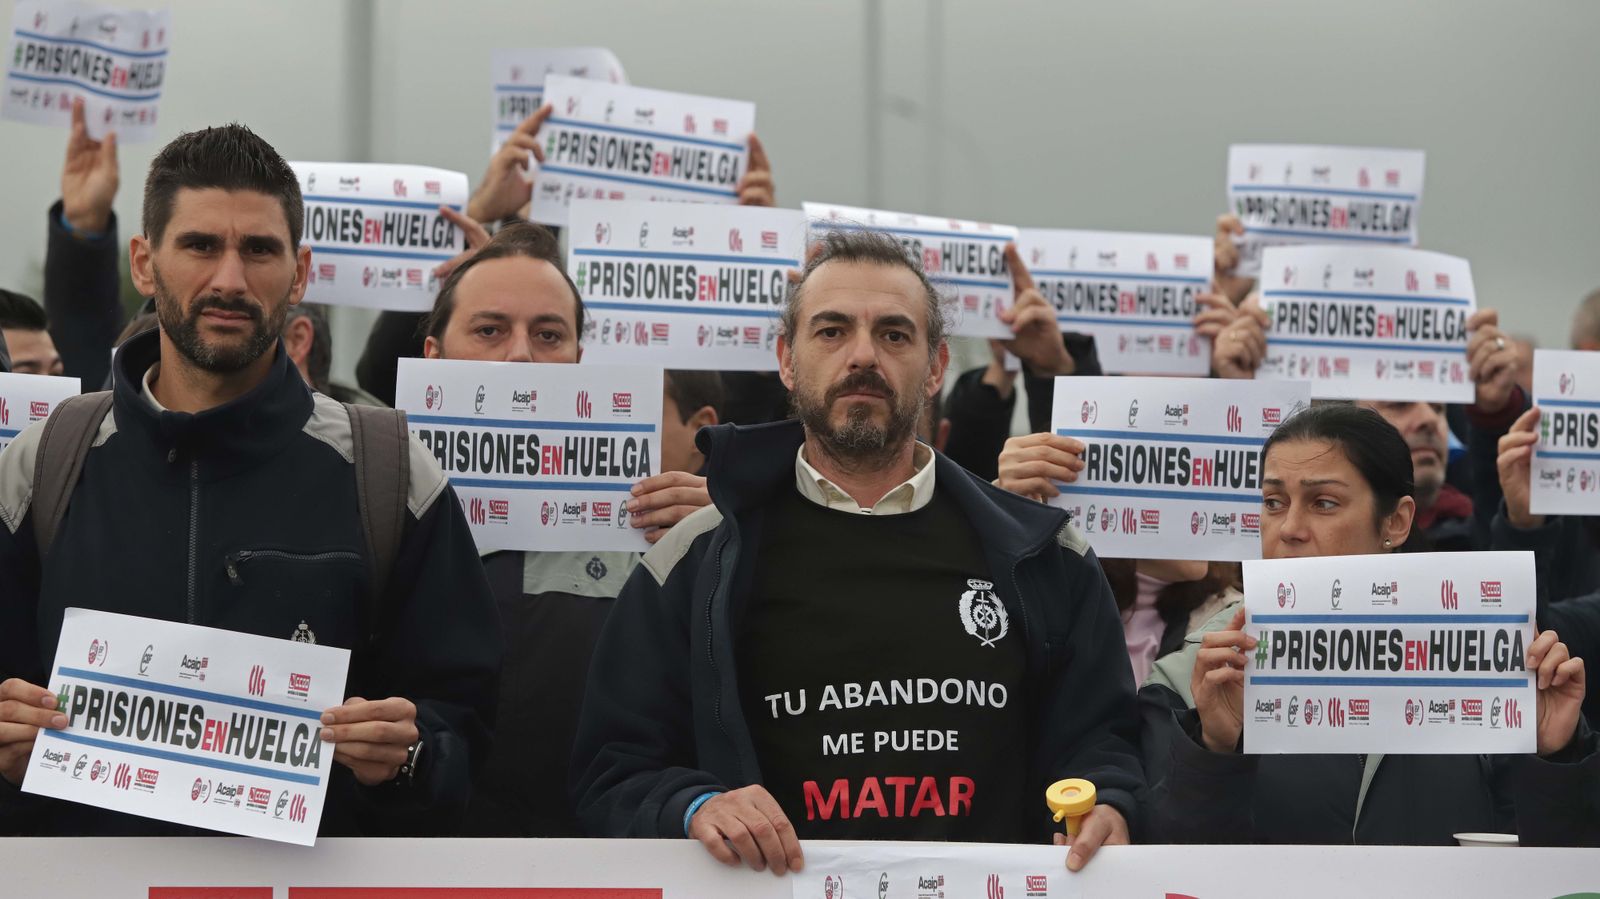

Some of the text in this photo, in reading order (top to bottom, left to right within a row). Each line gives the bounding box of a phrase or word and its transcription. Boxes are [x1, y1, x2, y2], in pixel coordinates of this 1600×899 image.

[304, 205, 455, 249] IONESENHUELGA
[576, 261, 787, 305] #PRISIONESENHUELG
[1540, 411, 1600, 448] #PRIS
[418, 429, 651, 479] PRISIONESENHUELGA
[1371, 582, 1391, 599] Acaip
[1254, 628, 1526, 673] #PRISIONESENHUELGA
[764, 678, 1008, 719] TU ABANDONO
[1255, 699, 1275, 715] Acaip
[1428, 700, 1448, 716] Acaip
[822, 730, 959, 756] ME PUEDE
[803, 776, 976, 820] MATAR
[918, 876, 937, 892] Acaip
